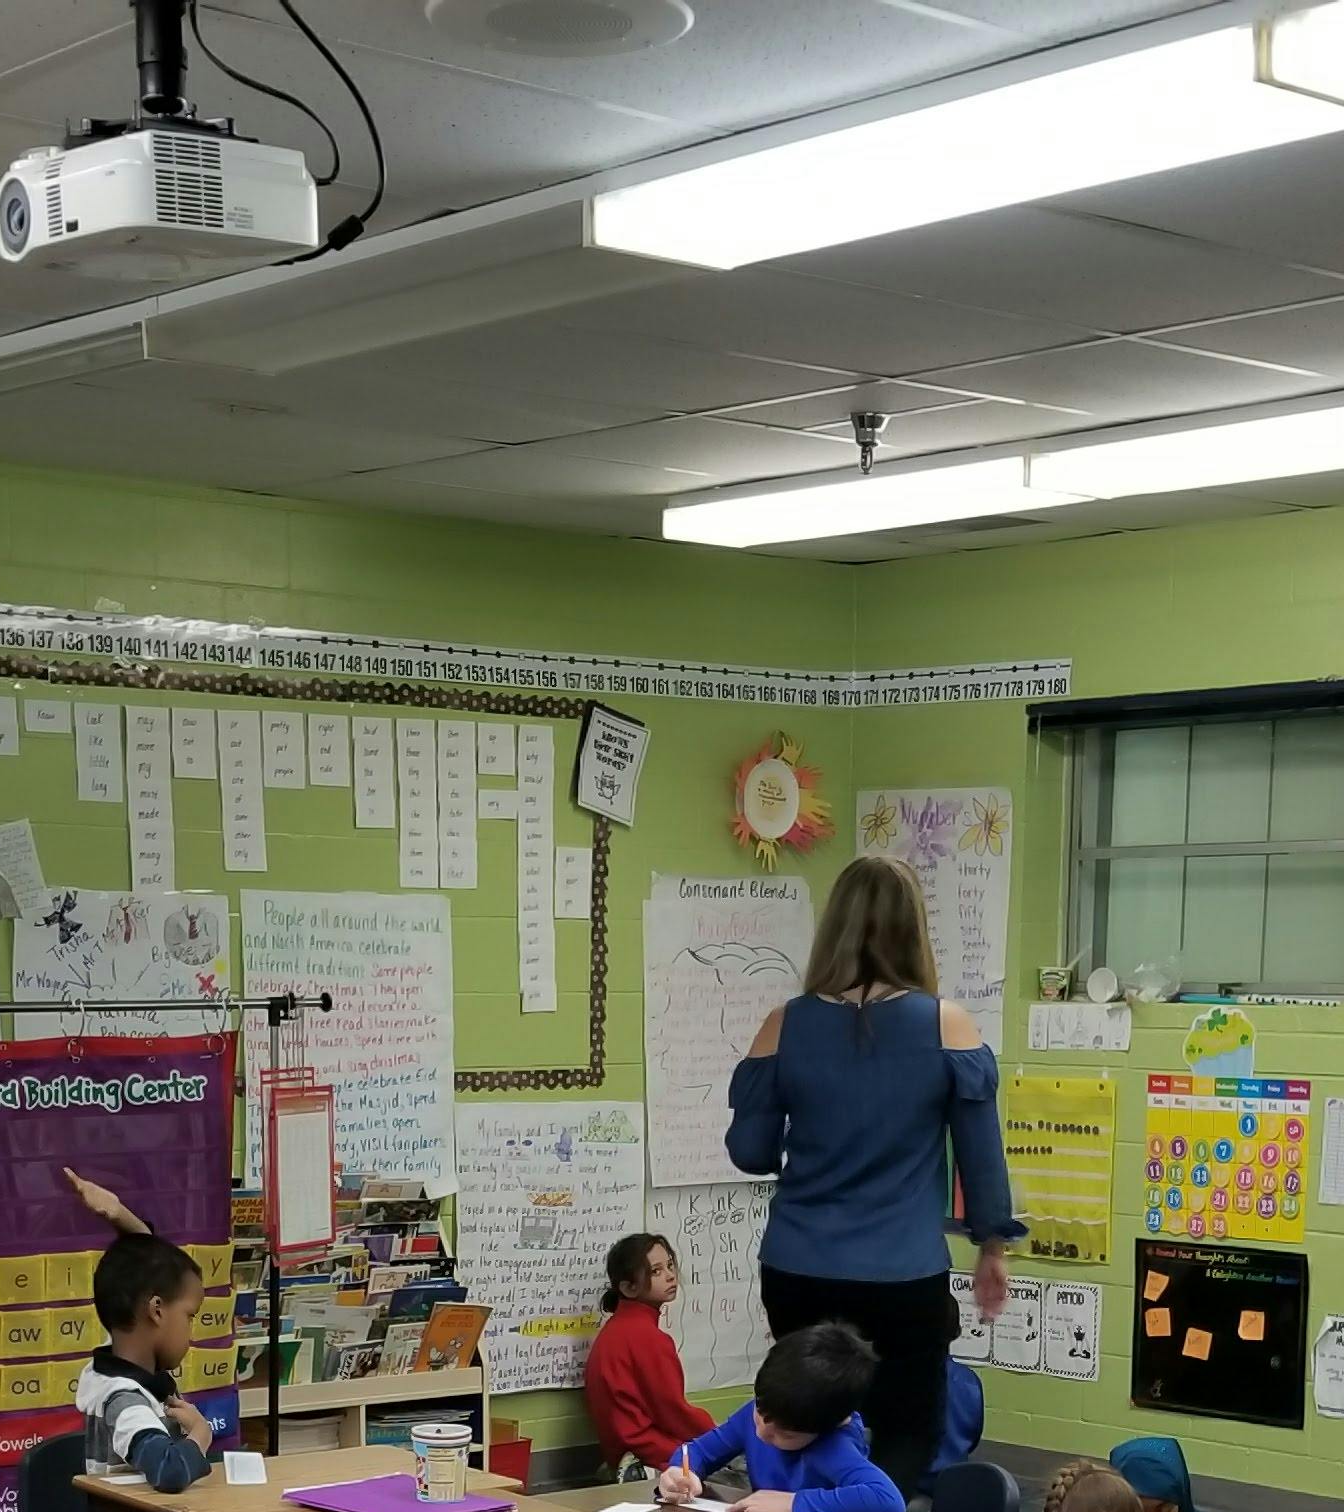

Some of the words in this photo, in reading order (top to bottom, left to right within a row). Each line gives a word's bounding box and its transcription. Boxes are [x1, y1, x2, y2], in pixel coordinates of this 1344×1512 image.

[28, 630, 54, 650] 137
[172, 640, 197, 661] 142
[259, 648, 285, 667] 145
[314, 652, 337, 671] 147
[364, 657, 388, 675] 149
[390, 659, 413, 678] 150
[415, 661, 438, 680] 151
[488, 666, 511, 685] 154
[680, 878, 744, 898] Consonant
[750, 880, 797, 900] Blends
[264, 900, 305, 932] People
[310, 908, 329, 928] all
[335, 911, 378, 931] around
[384, 914, 406, 932] the
[358, 939, 412, 956] celebrate
[21, 1076, 123, 1111] Building
[125, 1070, 208, 1105] Center
[372, 1159, 400, 1172] their
[403, 1158, 442, 1178] family
[210, 1258, 220, 1276] y
[721, 1259, 741, 1282] th
[14, 1272, 28, 1290] e
[201, 1311, 228, 1326] ew
[719, 1298, 736, 1322] qu
[8, 1327, 42, 1344] aw
[60, 1320, 85, 1341] ay
[204, 1360, 228, 1376] ue
[12, 1377, 40, 1394] oa
